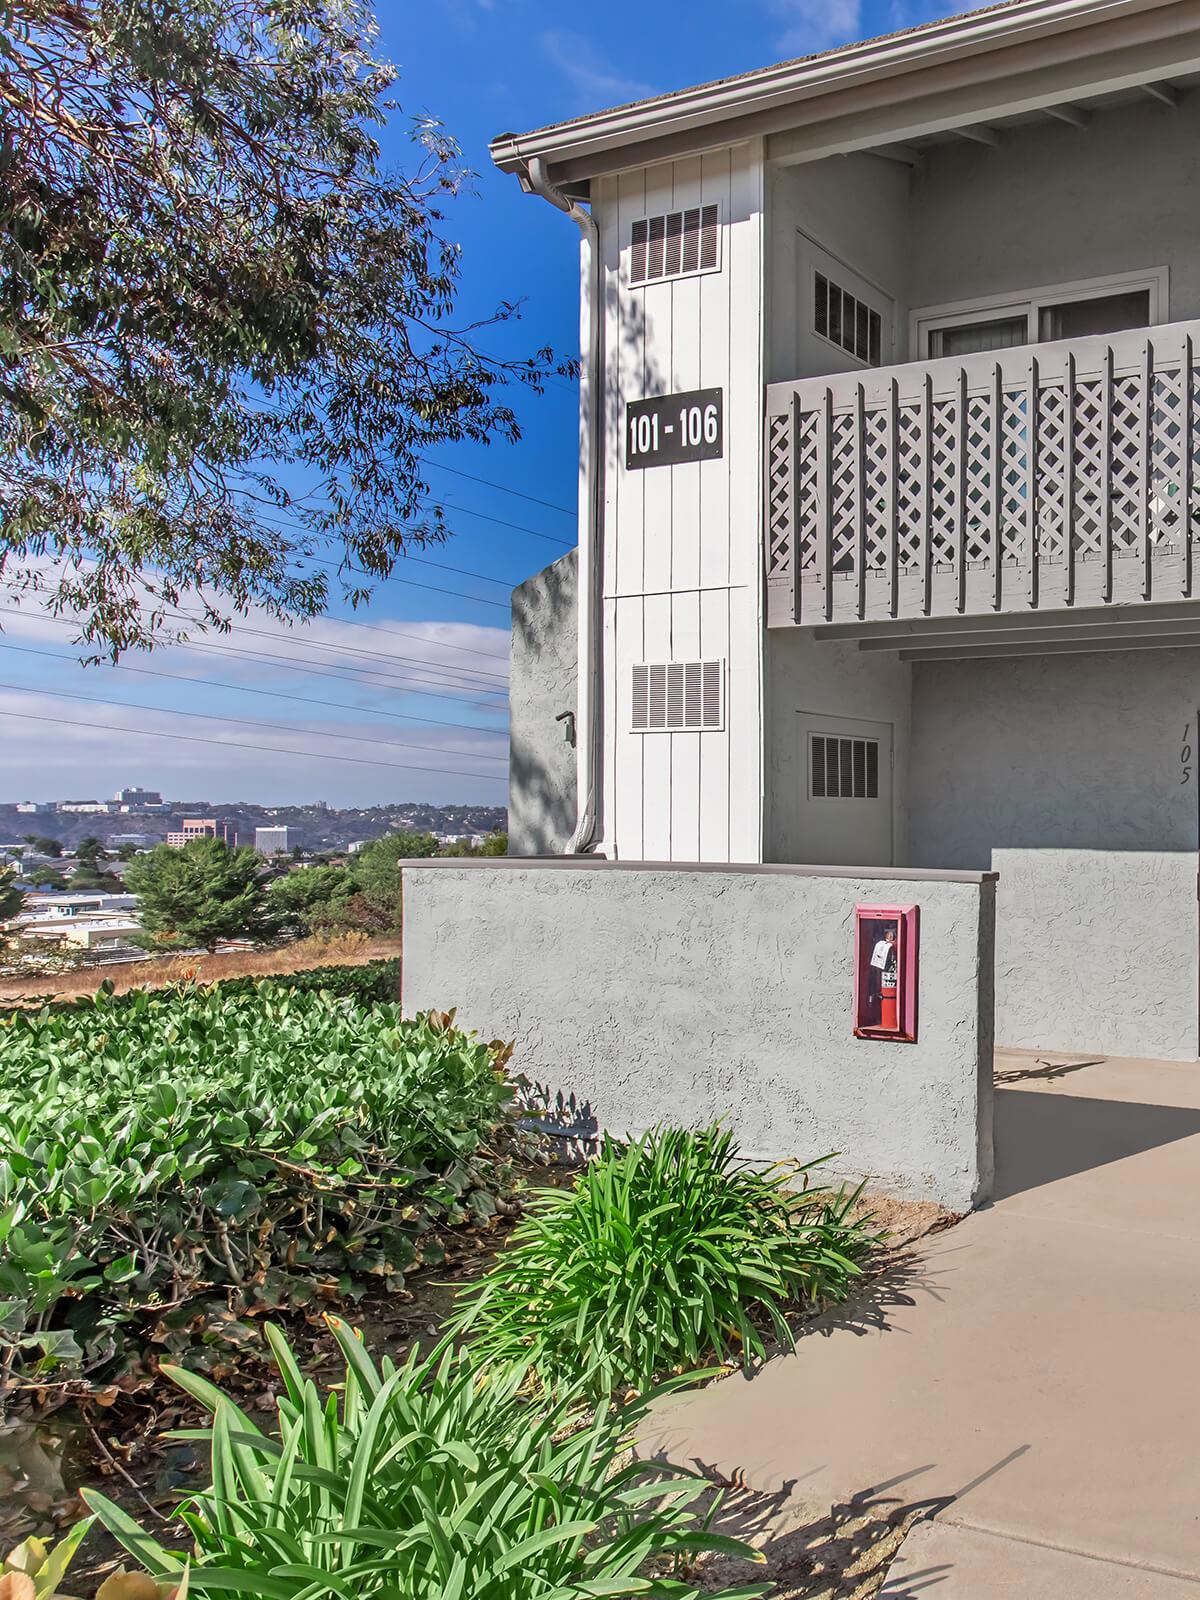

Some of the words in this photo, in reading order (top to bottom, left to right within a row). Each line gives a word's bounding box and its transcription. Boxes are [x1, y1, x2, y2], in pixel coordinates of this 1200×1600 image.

[630, 413, 658, 454] 101
[680, 404, 718, 447] 106
[1180, 724, 1192, 785] 105
